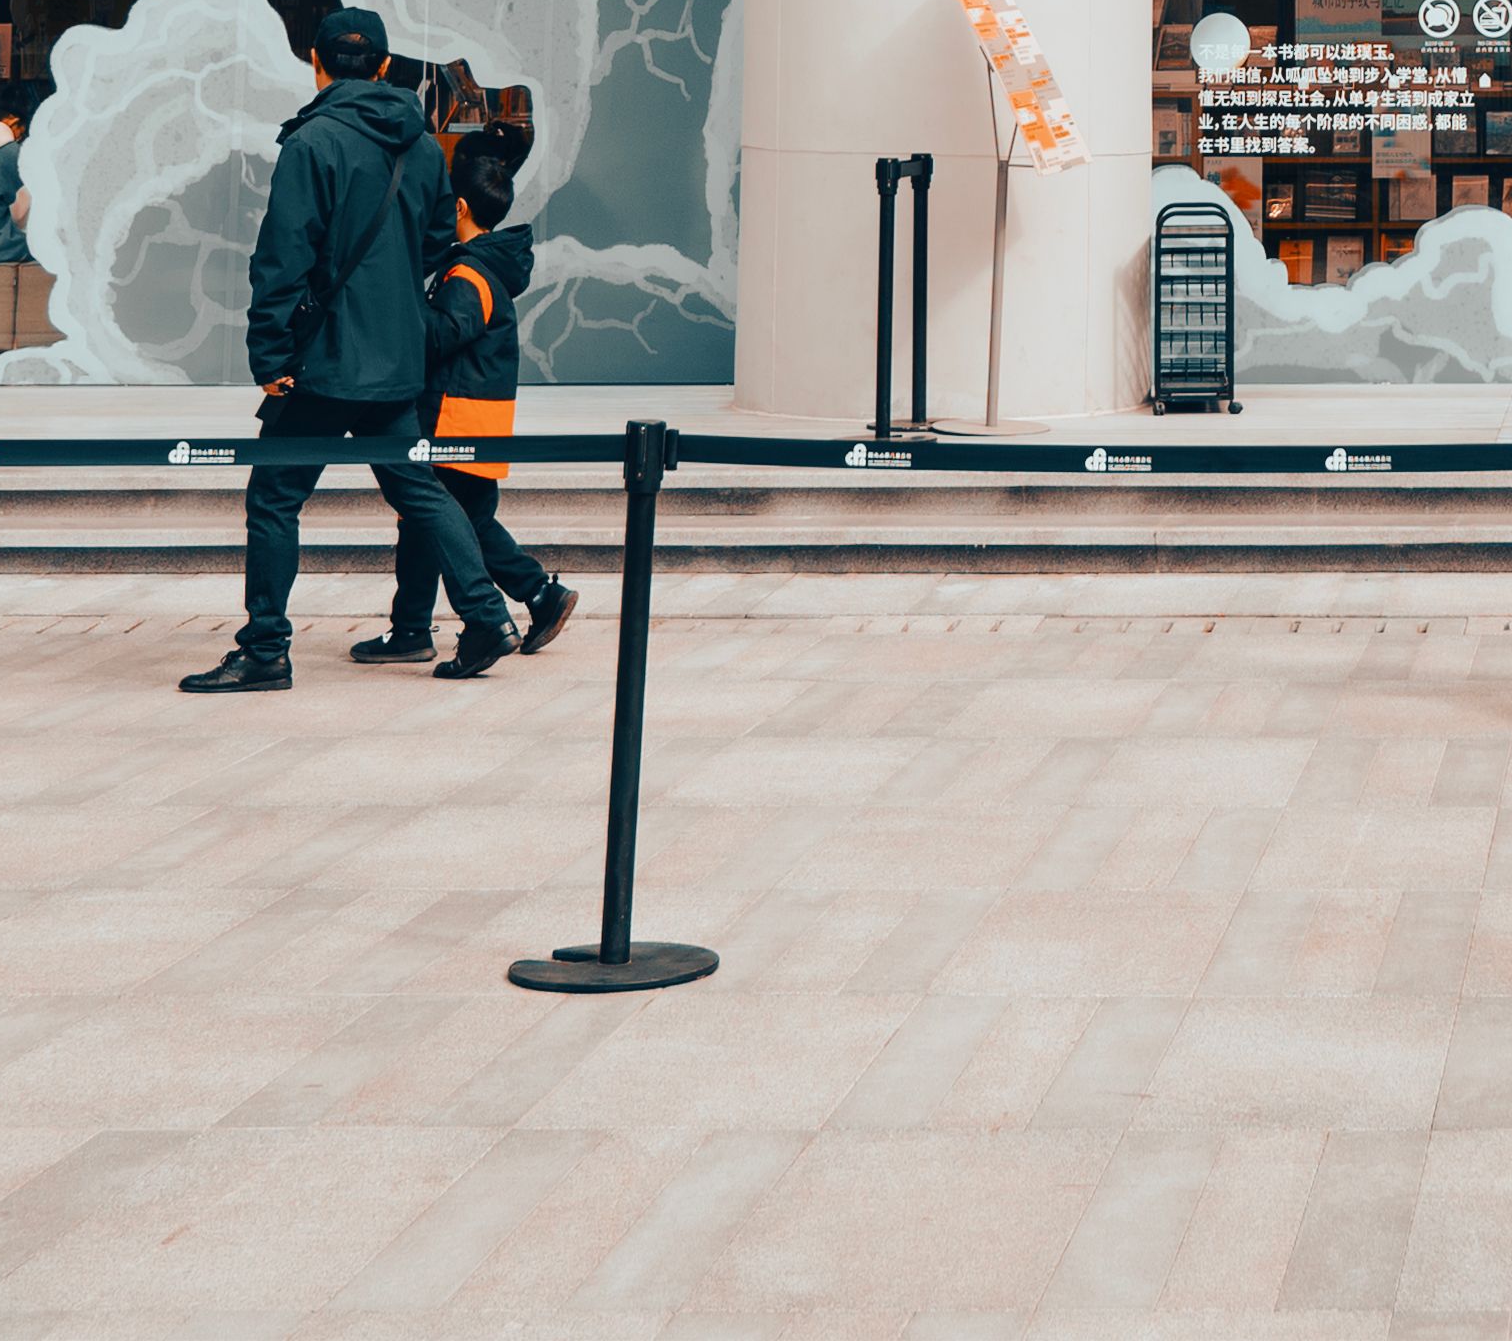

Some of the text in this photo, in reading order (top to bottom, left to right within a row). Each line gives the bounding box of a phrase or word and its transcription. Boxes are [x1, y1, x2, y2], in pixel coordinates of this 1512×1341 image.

[1197, 137, 1317, 155] 在书里找到答案。
